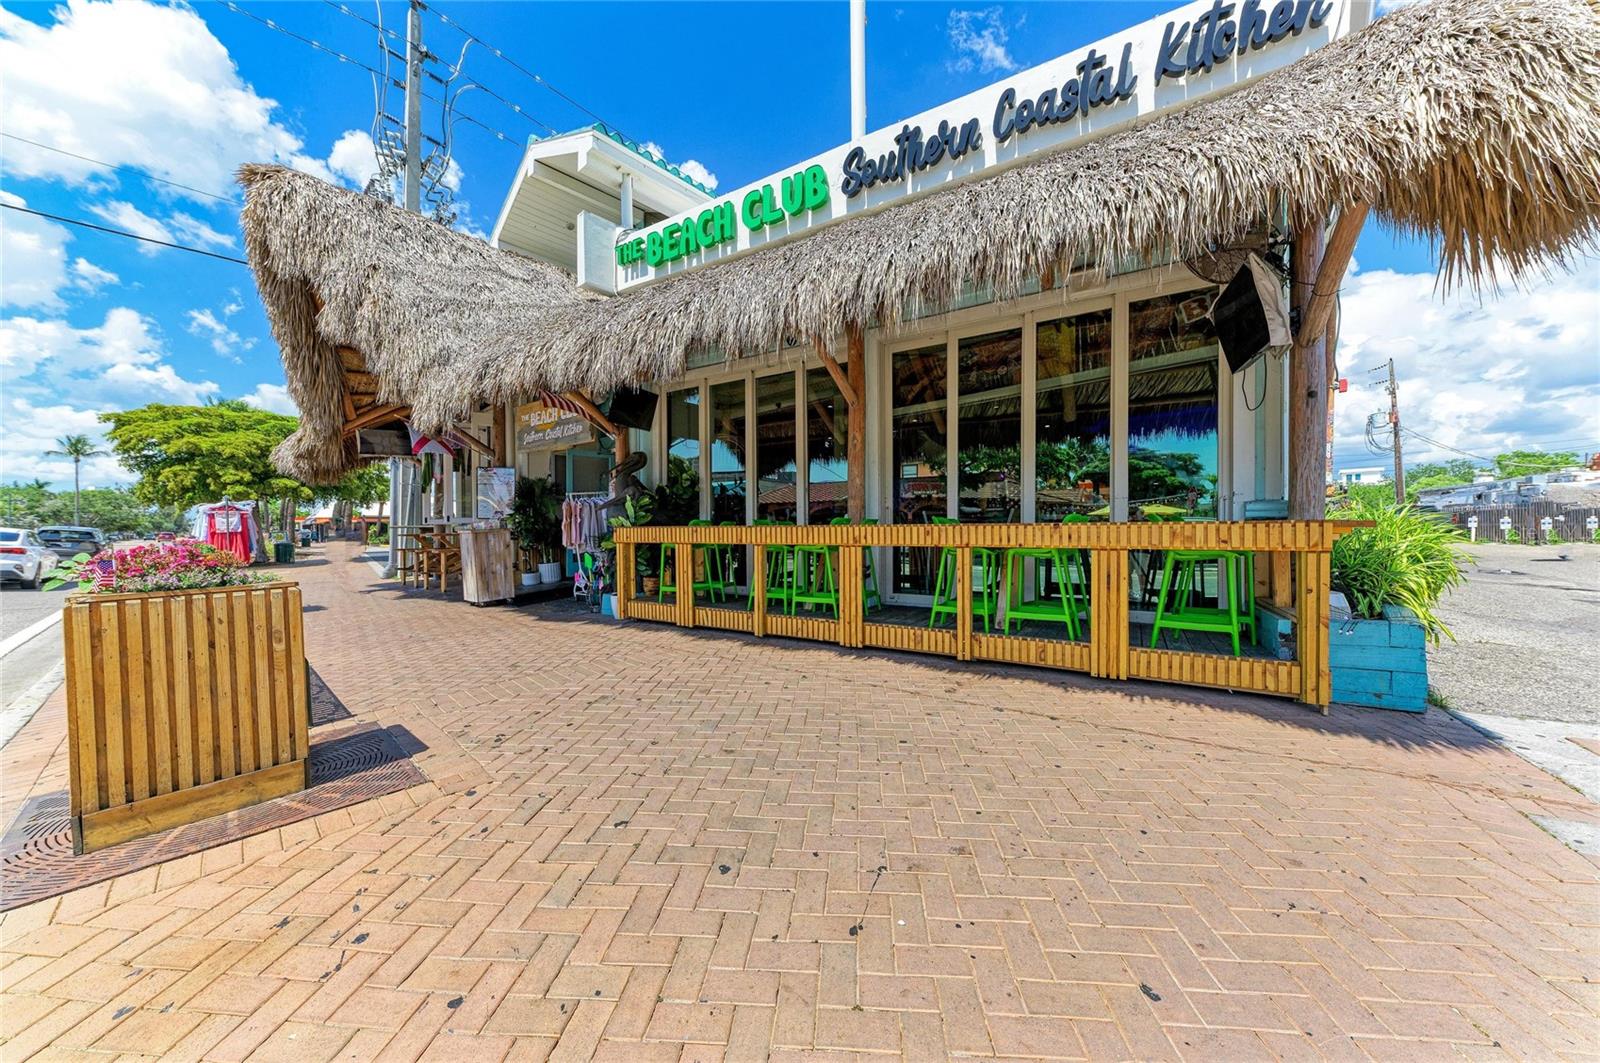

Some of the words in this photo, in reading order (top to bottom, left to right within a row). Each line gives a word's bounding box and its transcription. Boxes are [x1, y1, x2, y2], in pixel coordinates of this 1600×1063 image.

[615, 237, 645, 266] THE
[646, 200, 736, 267] BEACH
[741, 164, 829, 232] CLUB
[841, 117, 982, 198] Southern
[993, 42, 1137, 143] Coastal
[1154, 0, 1334, 87] Kitchen
[530, 407, 557, 426] BEACH
